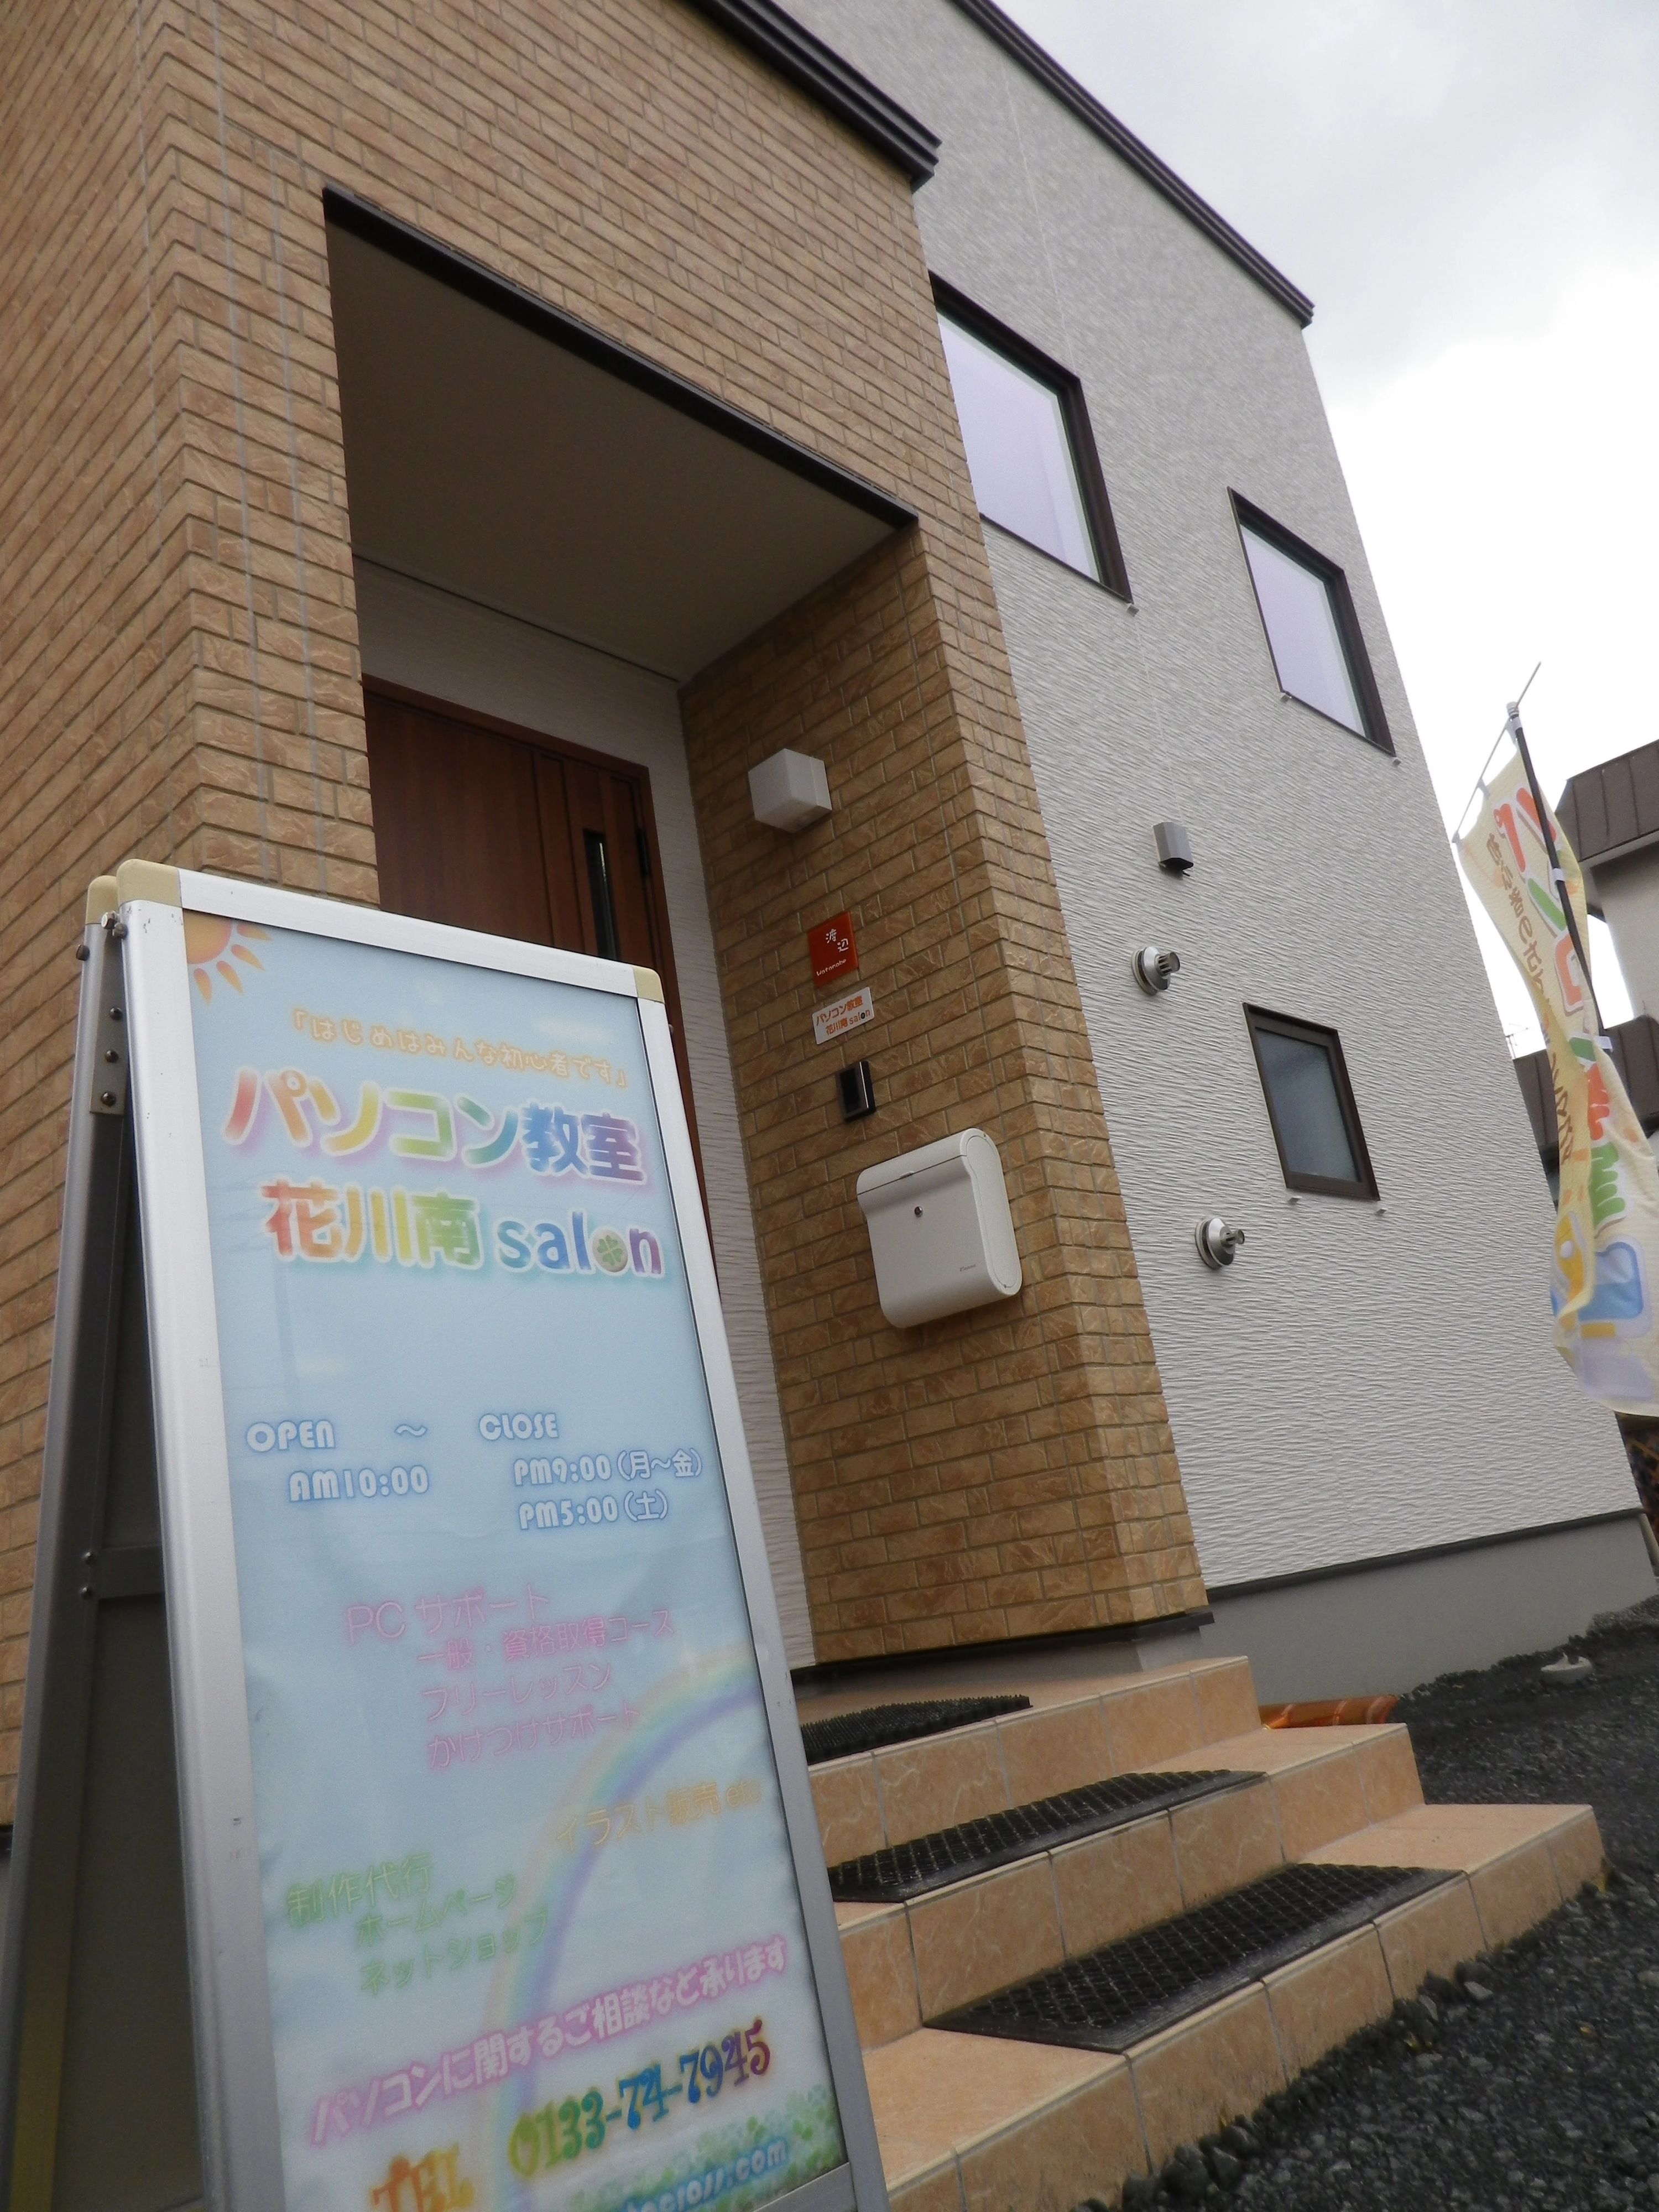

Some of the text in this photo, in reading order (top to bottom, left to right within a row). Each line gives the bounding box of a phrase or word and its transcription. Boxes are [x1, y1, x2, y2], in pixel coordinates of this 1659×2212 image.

[816, 995, 863, 1026] パソコン教室
[223, 1066, 648, 1185] パソコン教室
[247, 1419, 336, 1452] OPEN
[478, 1412, 559, 1440] CLOSE
[289, 1465, 429, 1502] AM10:00
[422, 1663, 611, 1721] フリーレッスン
[508, 2018, 771, 2178] 0133-74-7945
